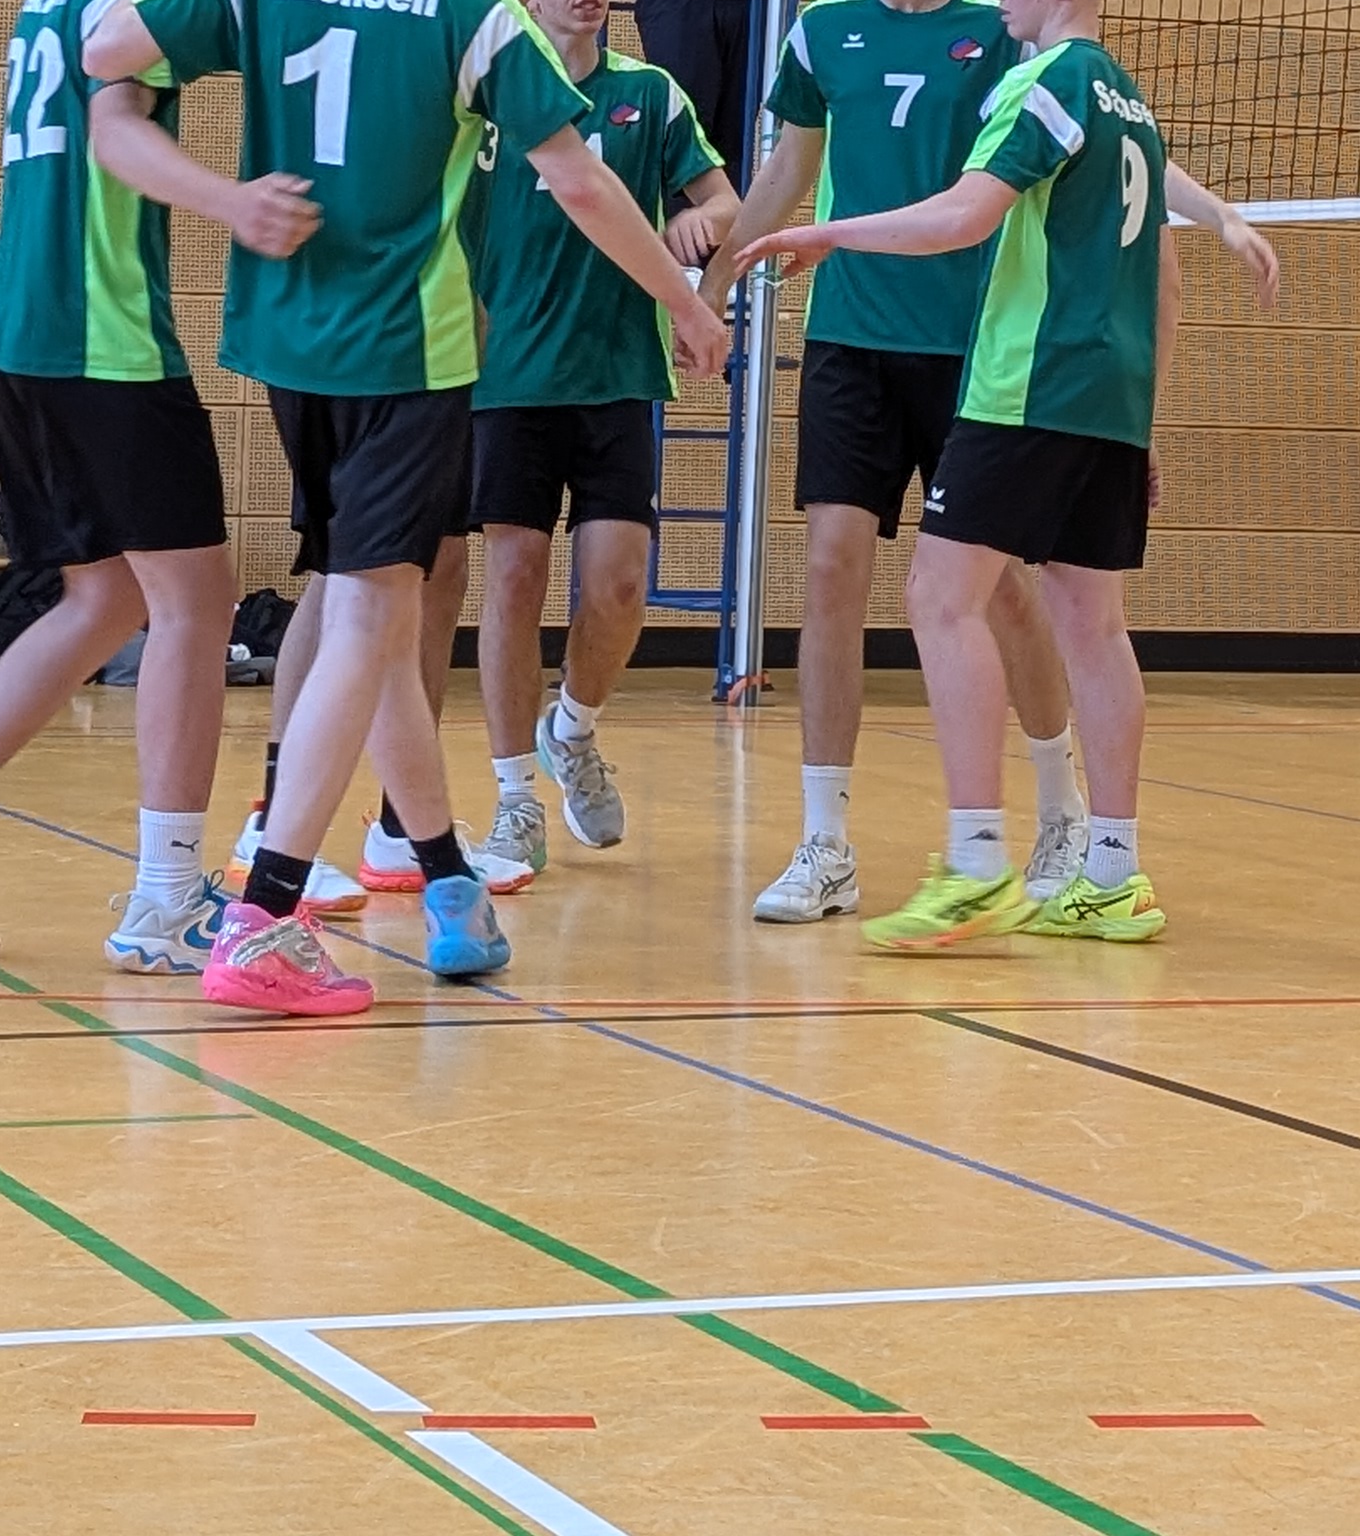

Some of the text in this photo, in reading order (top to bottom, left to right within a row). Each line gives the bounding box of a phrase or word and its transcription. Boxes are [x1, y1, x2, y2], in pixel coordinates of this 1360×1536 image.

[2, 26, 67, 167] 22
[283, 28, 359, 168] 1
[884, 73, 927, 128] 7
[1121, 134, 1150, 248] 9
